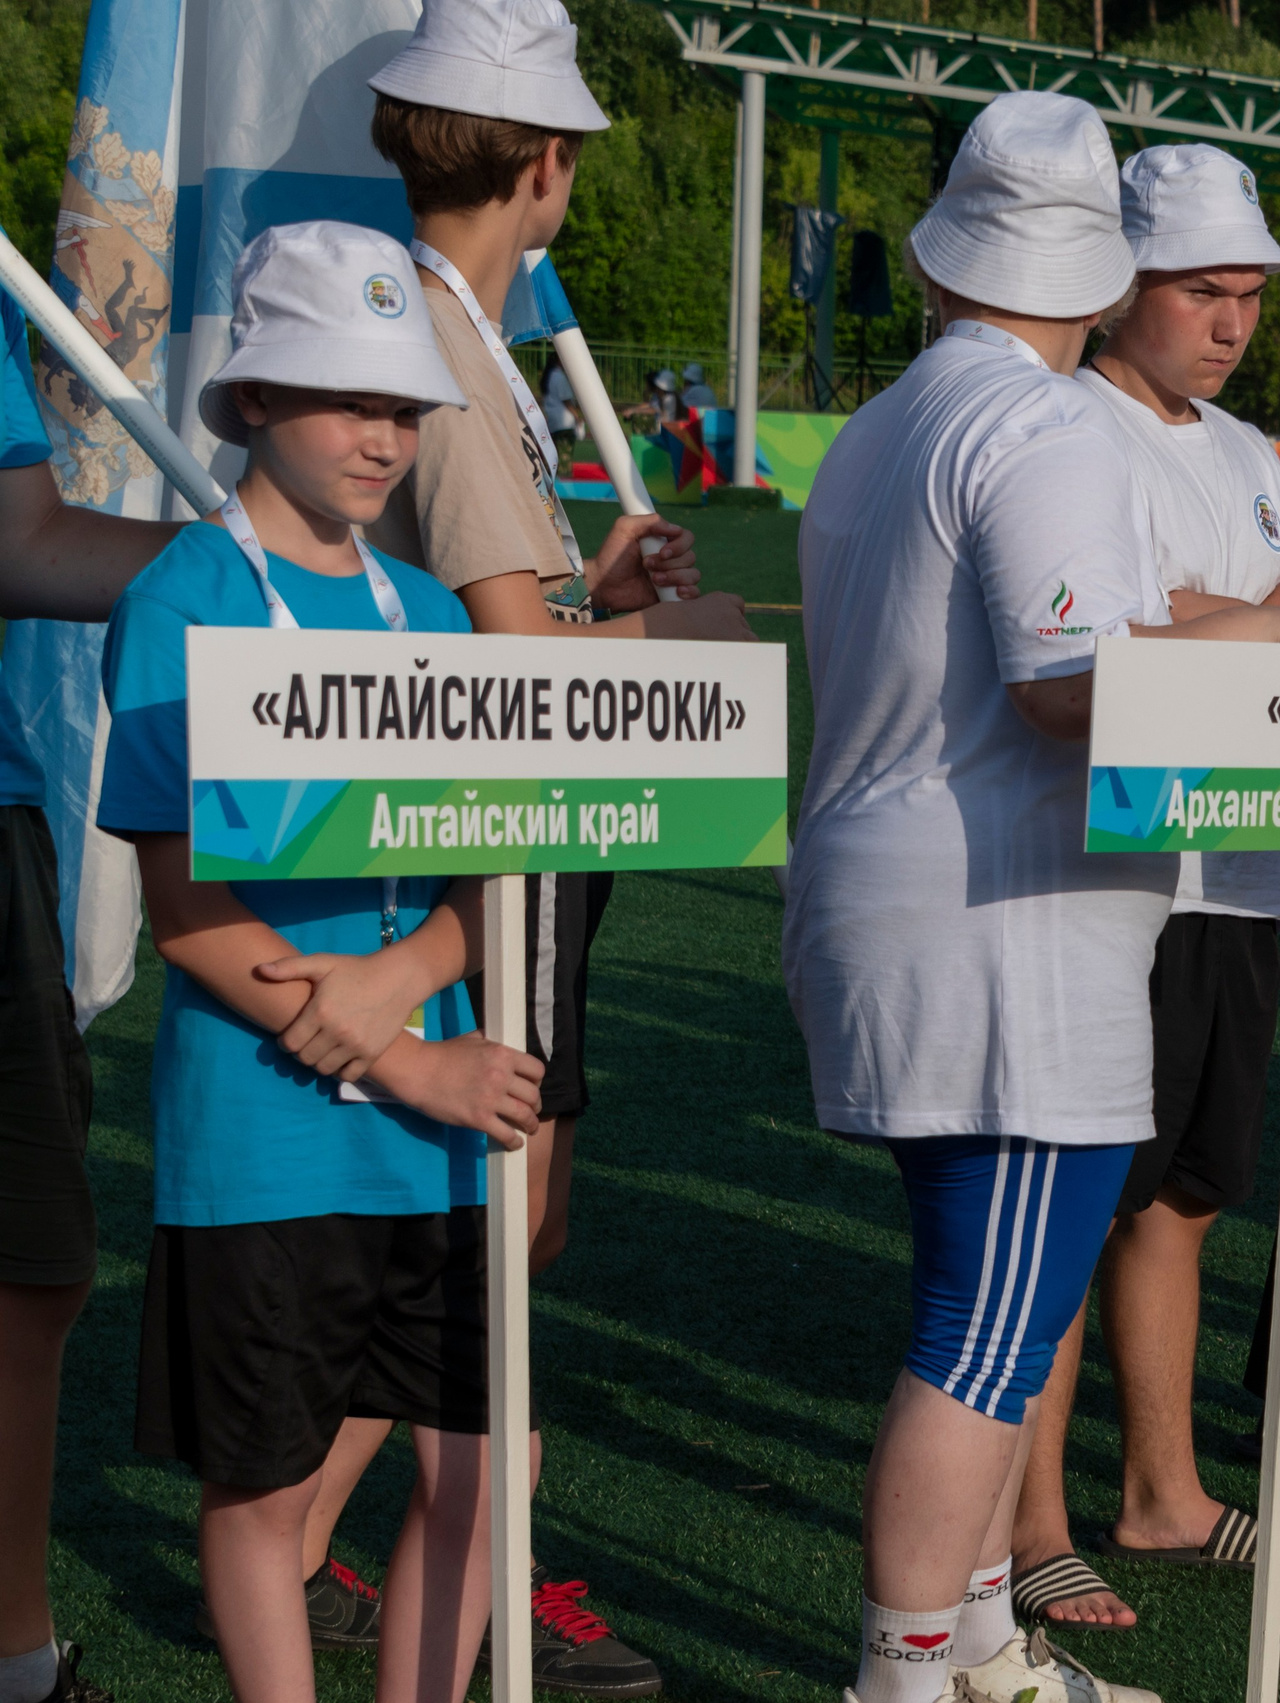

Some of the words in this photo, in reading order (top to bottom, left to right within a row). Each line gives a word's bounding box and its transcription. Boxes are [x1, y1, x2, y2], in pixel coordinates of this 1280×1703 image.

[1036, 626, 1094, 636] TATNEFT
[251, 657, 553, 741] «АЛТАЙСКИЕ
[566, 678, 747, 743] СОРОКИ»
[369, 788, 569, 849] Алтайский
[579, 788, 660, 858] край
[876, 1629, 895, 1645] I
[868, 1642, 954, 1662] SOCHI
